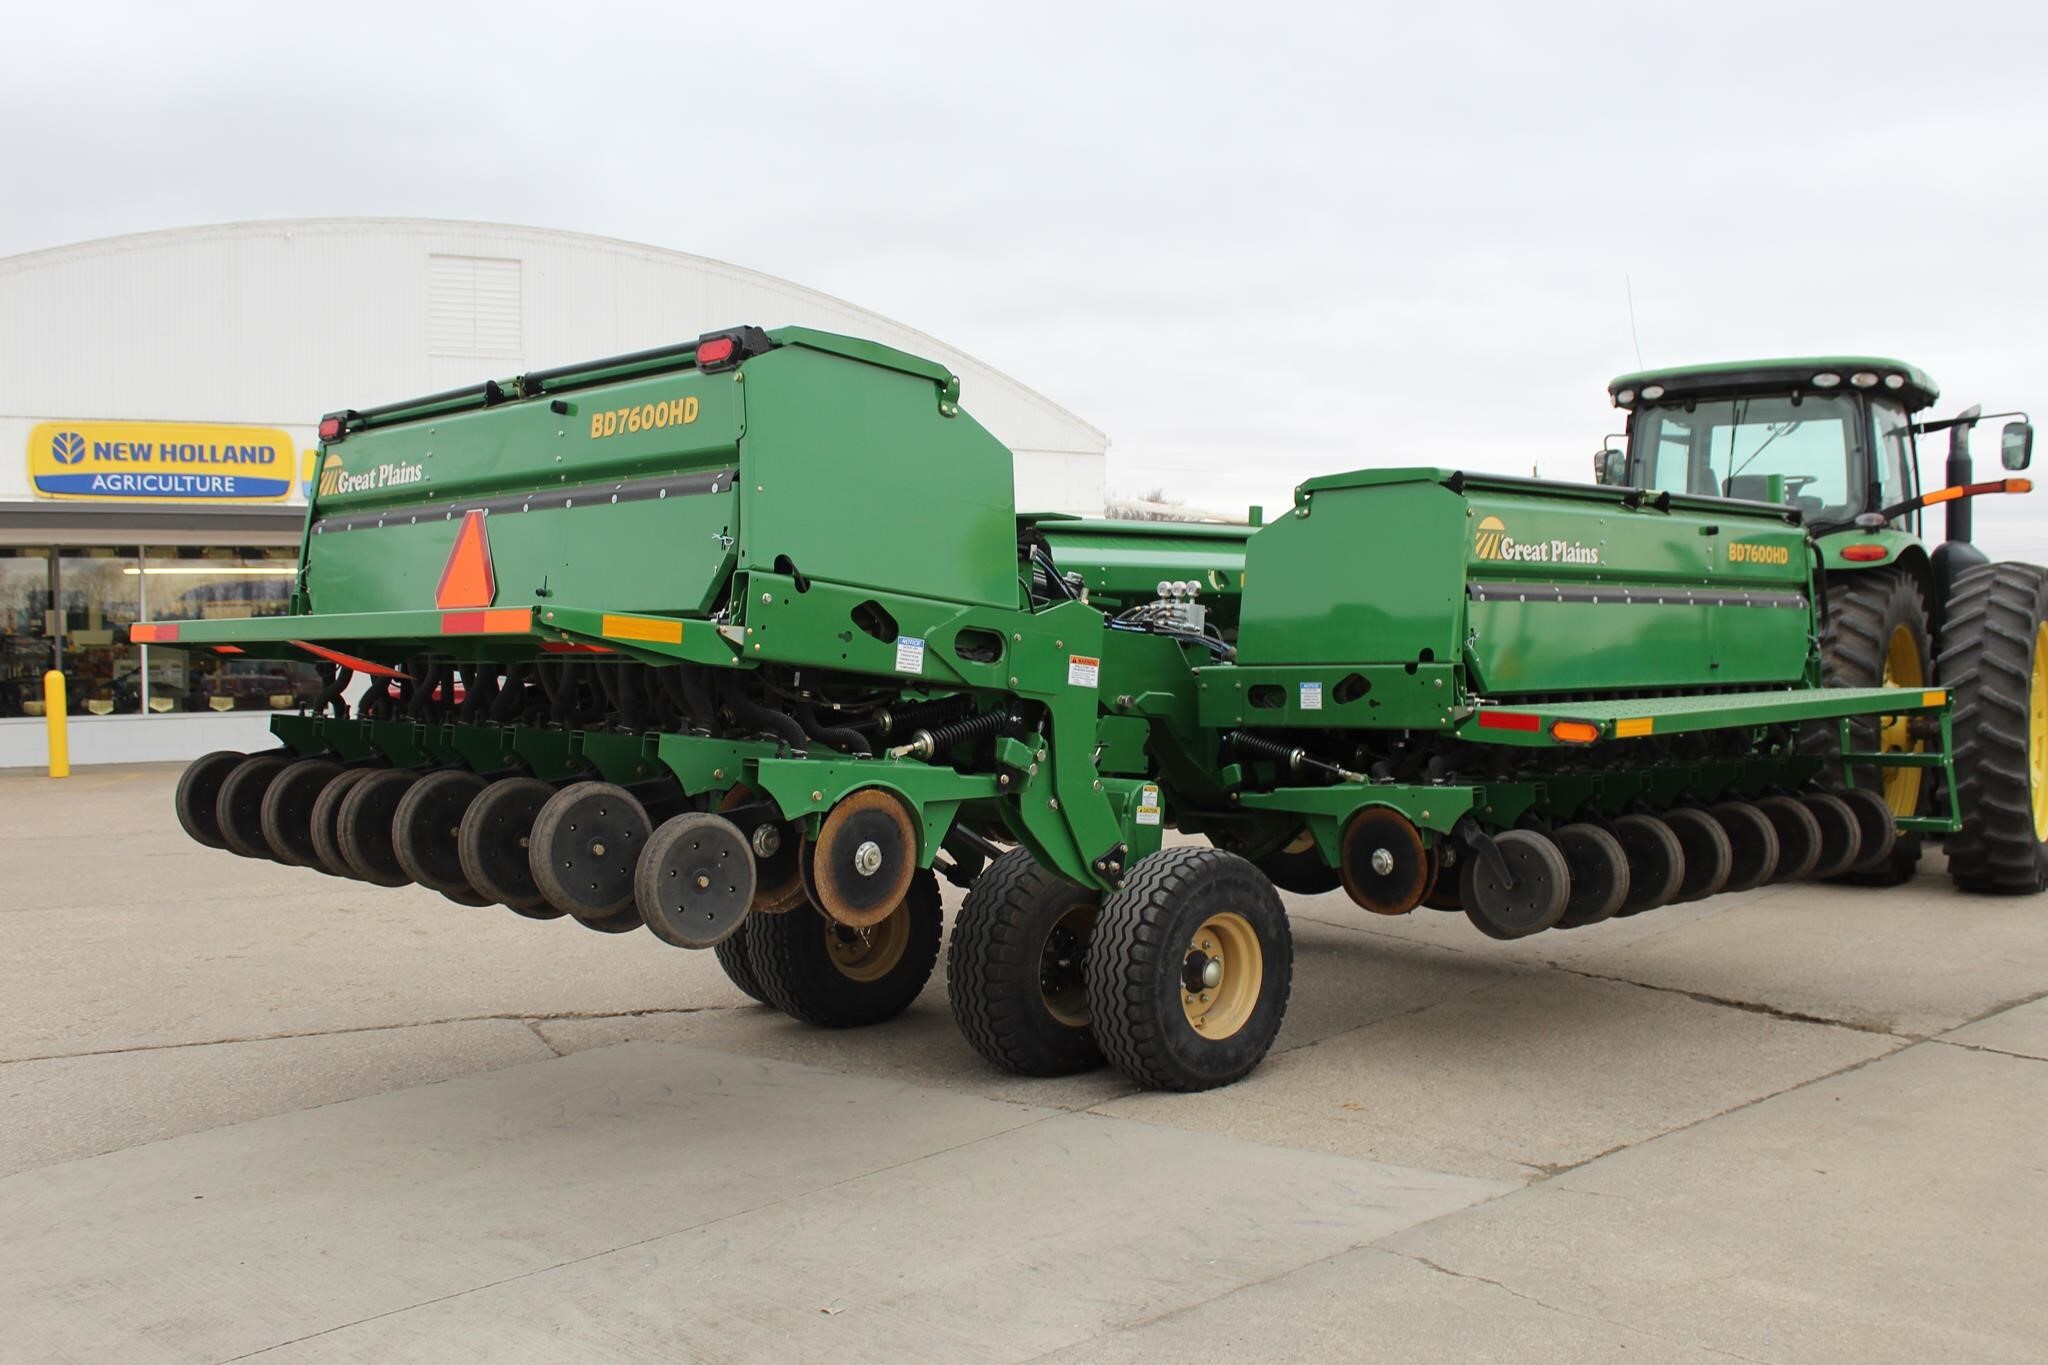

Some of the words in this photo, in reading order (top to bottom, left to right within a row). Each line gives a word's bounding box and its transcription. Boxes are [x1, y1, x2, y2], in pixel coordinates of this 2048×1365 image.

[590, 396, 699, 440] BD7600HD
[93, 441, 153, 462] NEW
[160, 443, 276, 464] HOLLAND
[91, 474, 236, 493] AGRICULTURE
[337, 468, 377, 494] Great
[377, 460, 423, 488] Plains
[1500, 536, 1547, 562] Great
[1550, 539, 1599, 565] Plains
[1727, 542, 1789, 566] BD7600HD
[901, 638, 921, 647] NOTICE
